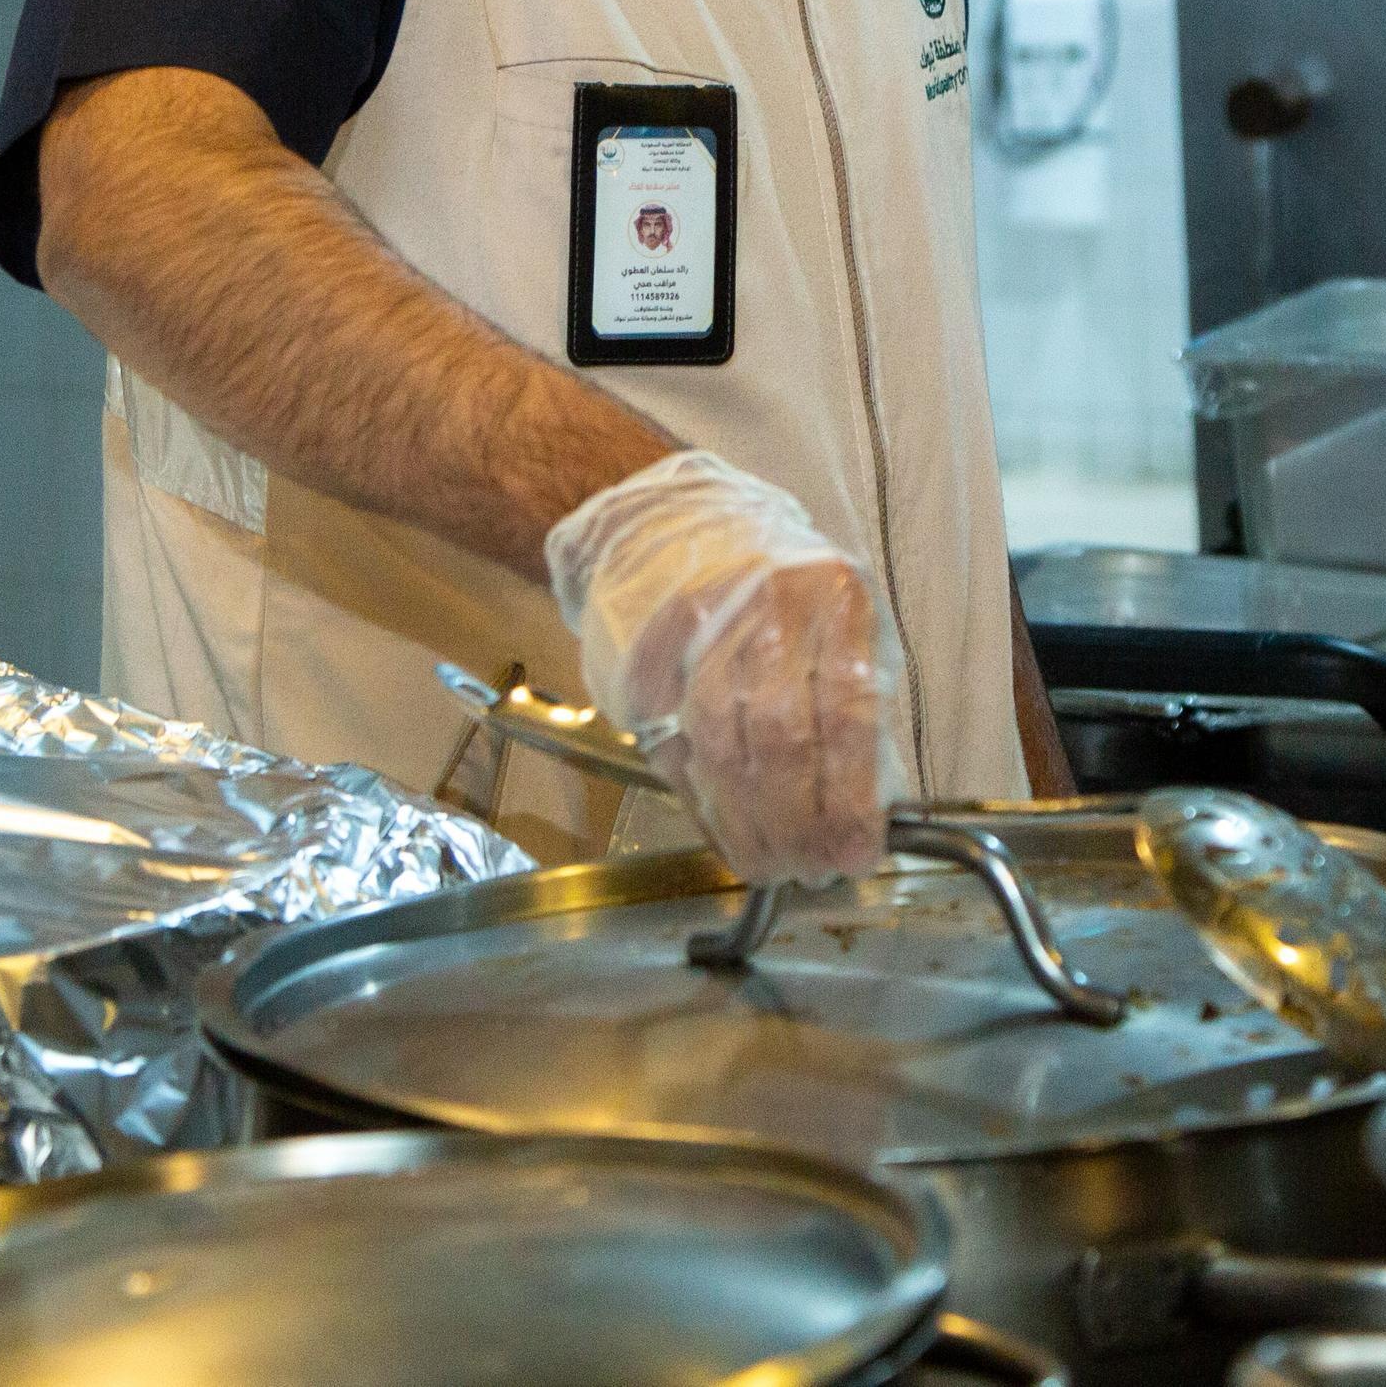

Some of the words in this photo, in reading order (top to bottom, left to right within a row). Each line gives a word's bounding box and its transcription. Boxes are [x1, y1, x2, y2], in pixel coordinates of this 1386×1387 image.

[621, 265, 649, 277] العطوي
[633, 281, 652, 290] صحي
[653, 279, 677, 288] مراقب
